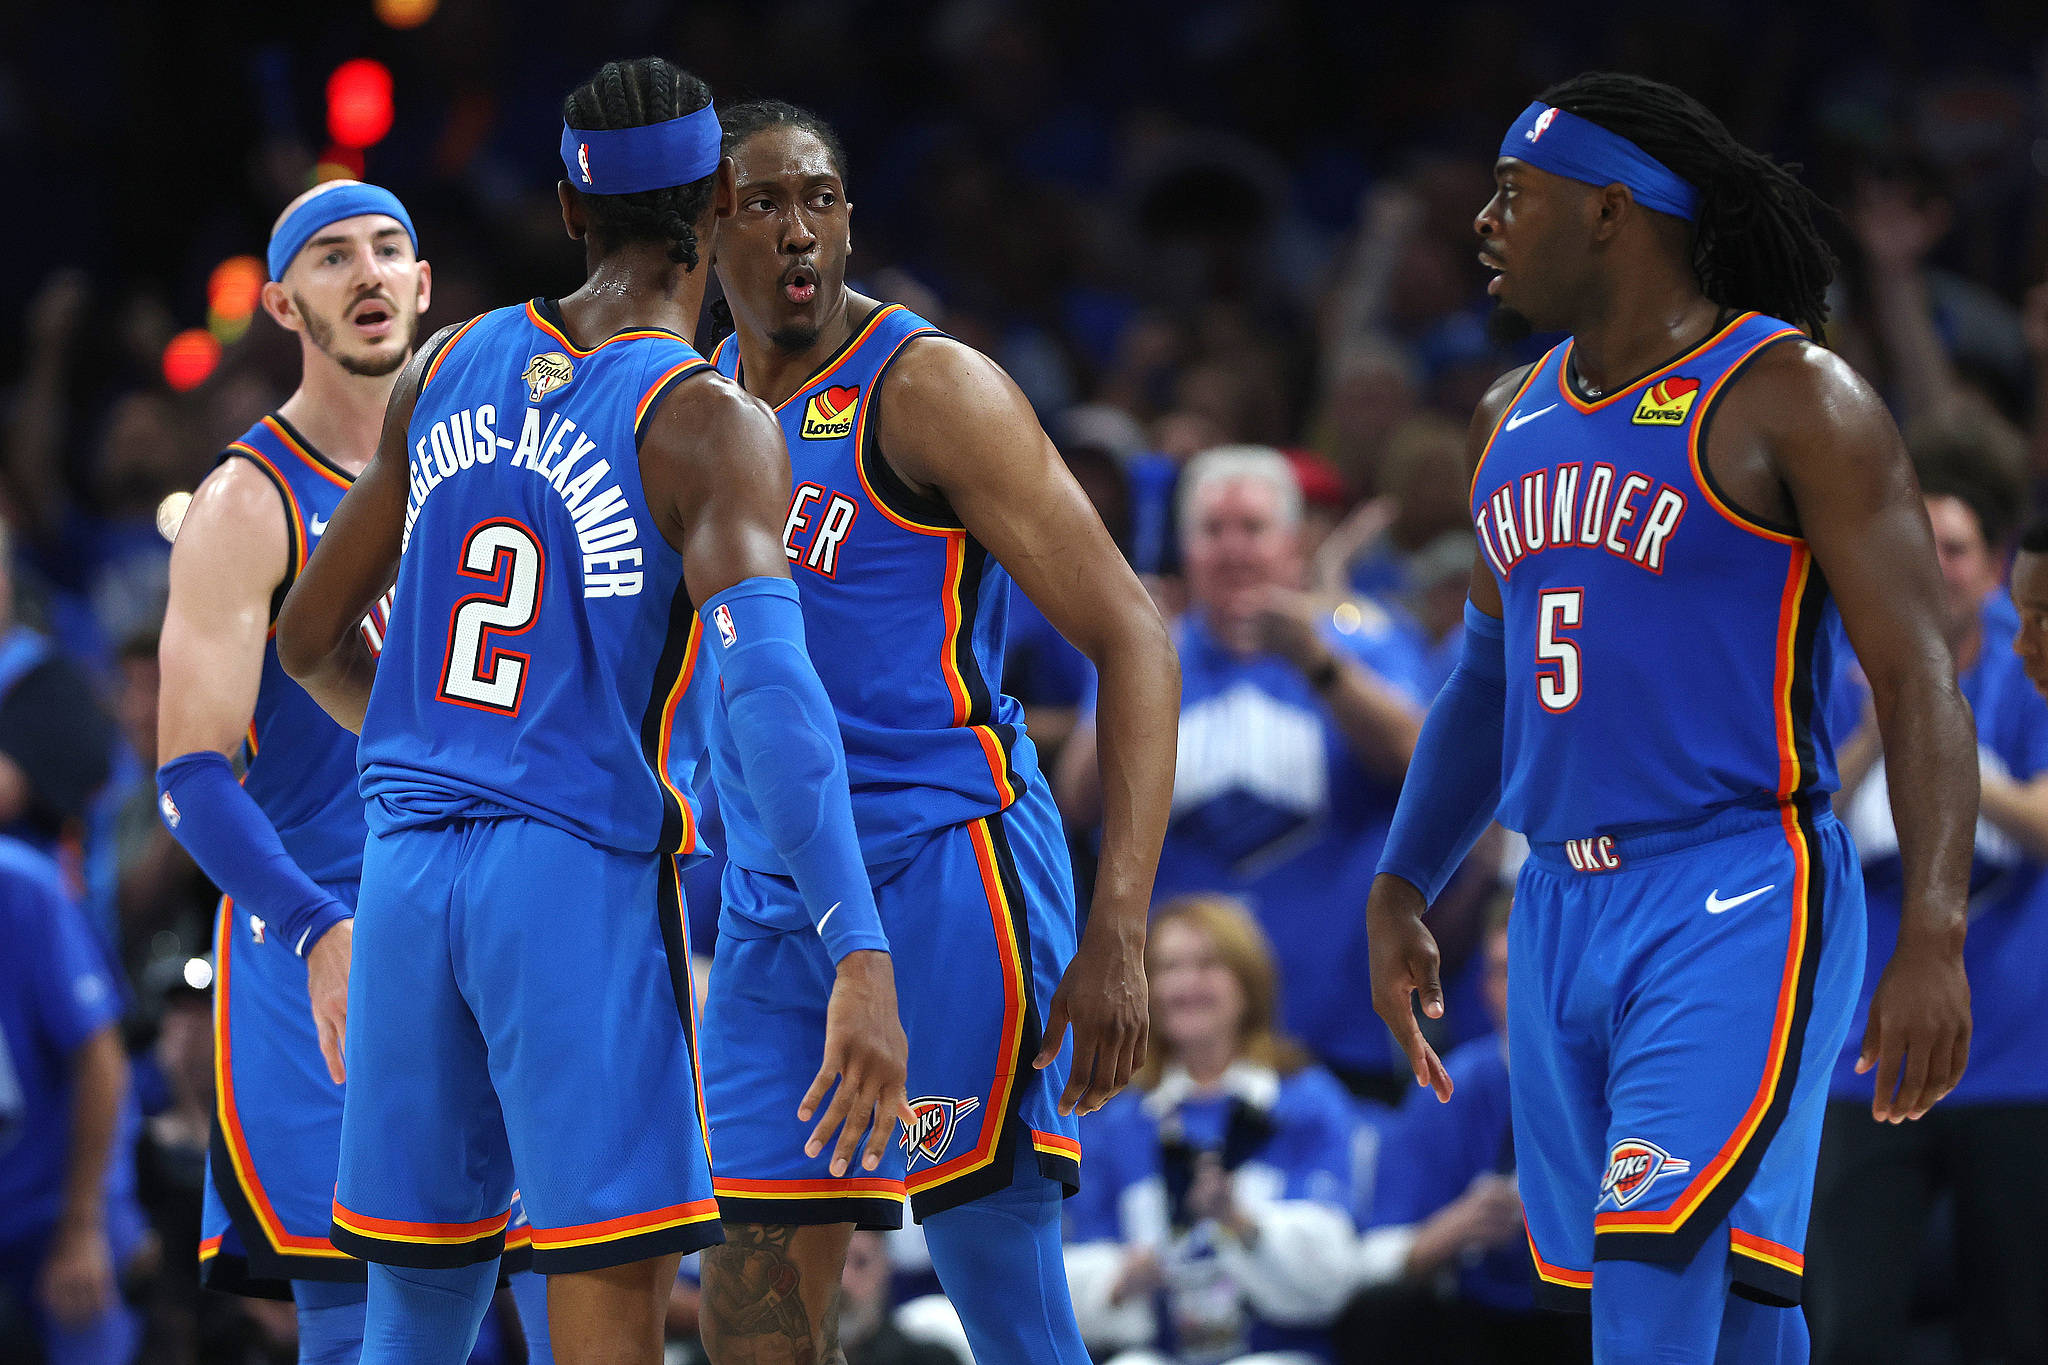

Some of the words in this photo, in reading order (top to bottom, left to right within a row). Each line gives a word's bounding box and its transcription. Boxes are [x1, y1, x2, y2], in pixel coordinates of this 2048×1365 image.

[522, 356, 572, 381] Finals
[1476, 461, 1688, 582] THUNDER
[434, 516, 546, 718] 2
[1535, 586, 1584, 714] 5
[1565, 836, 1621, 872] OKC
[1603, 1154, 1650, 1192] OKC
